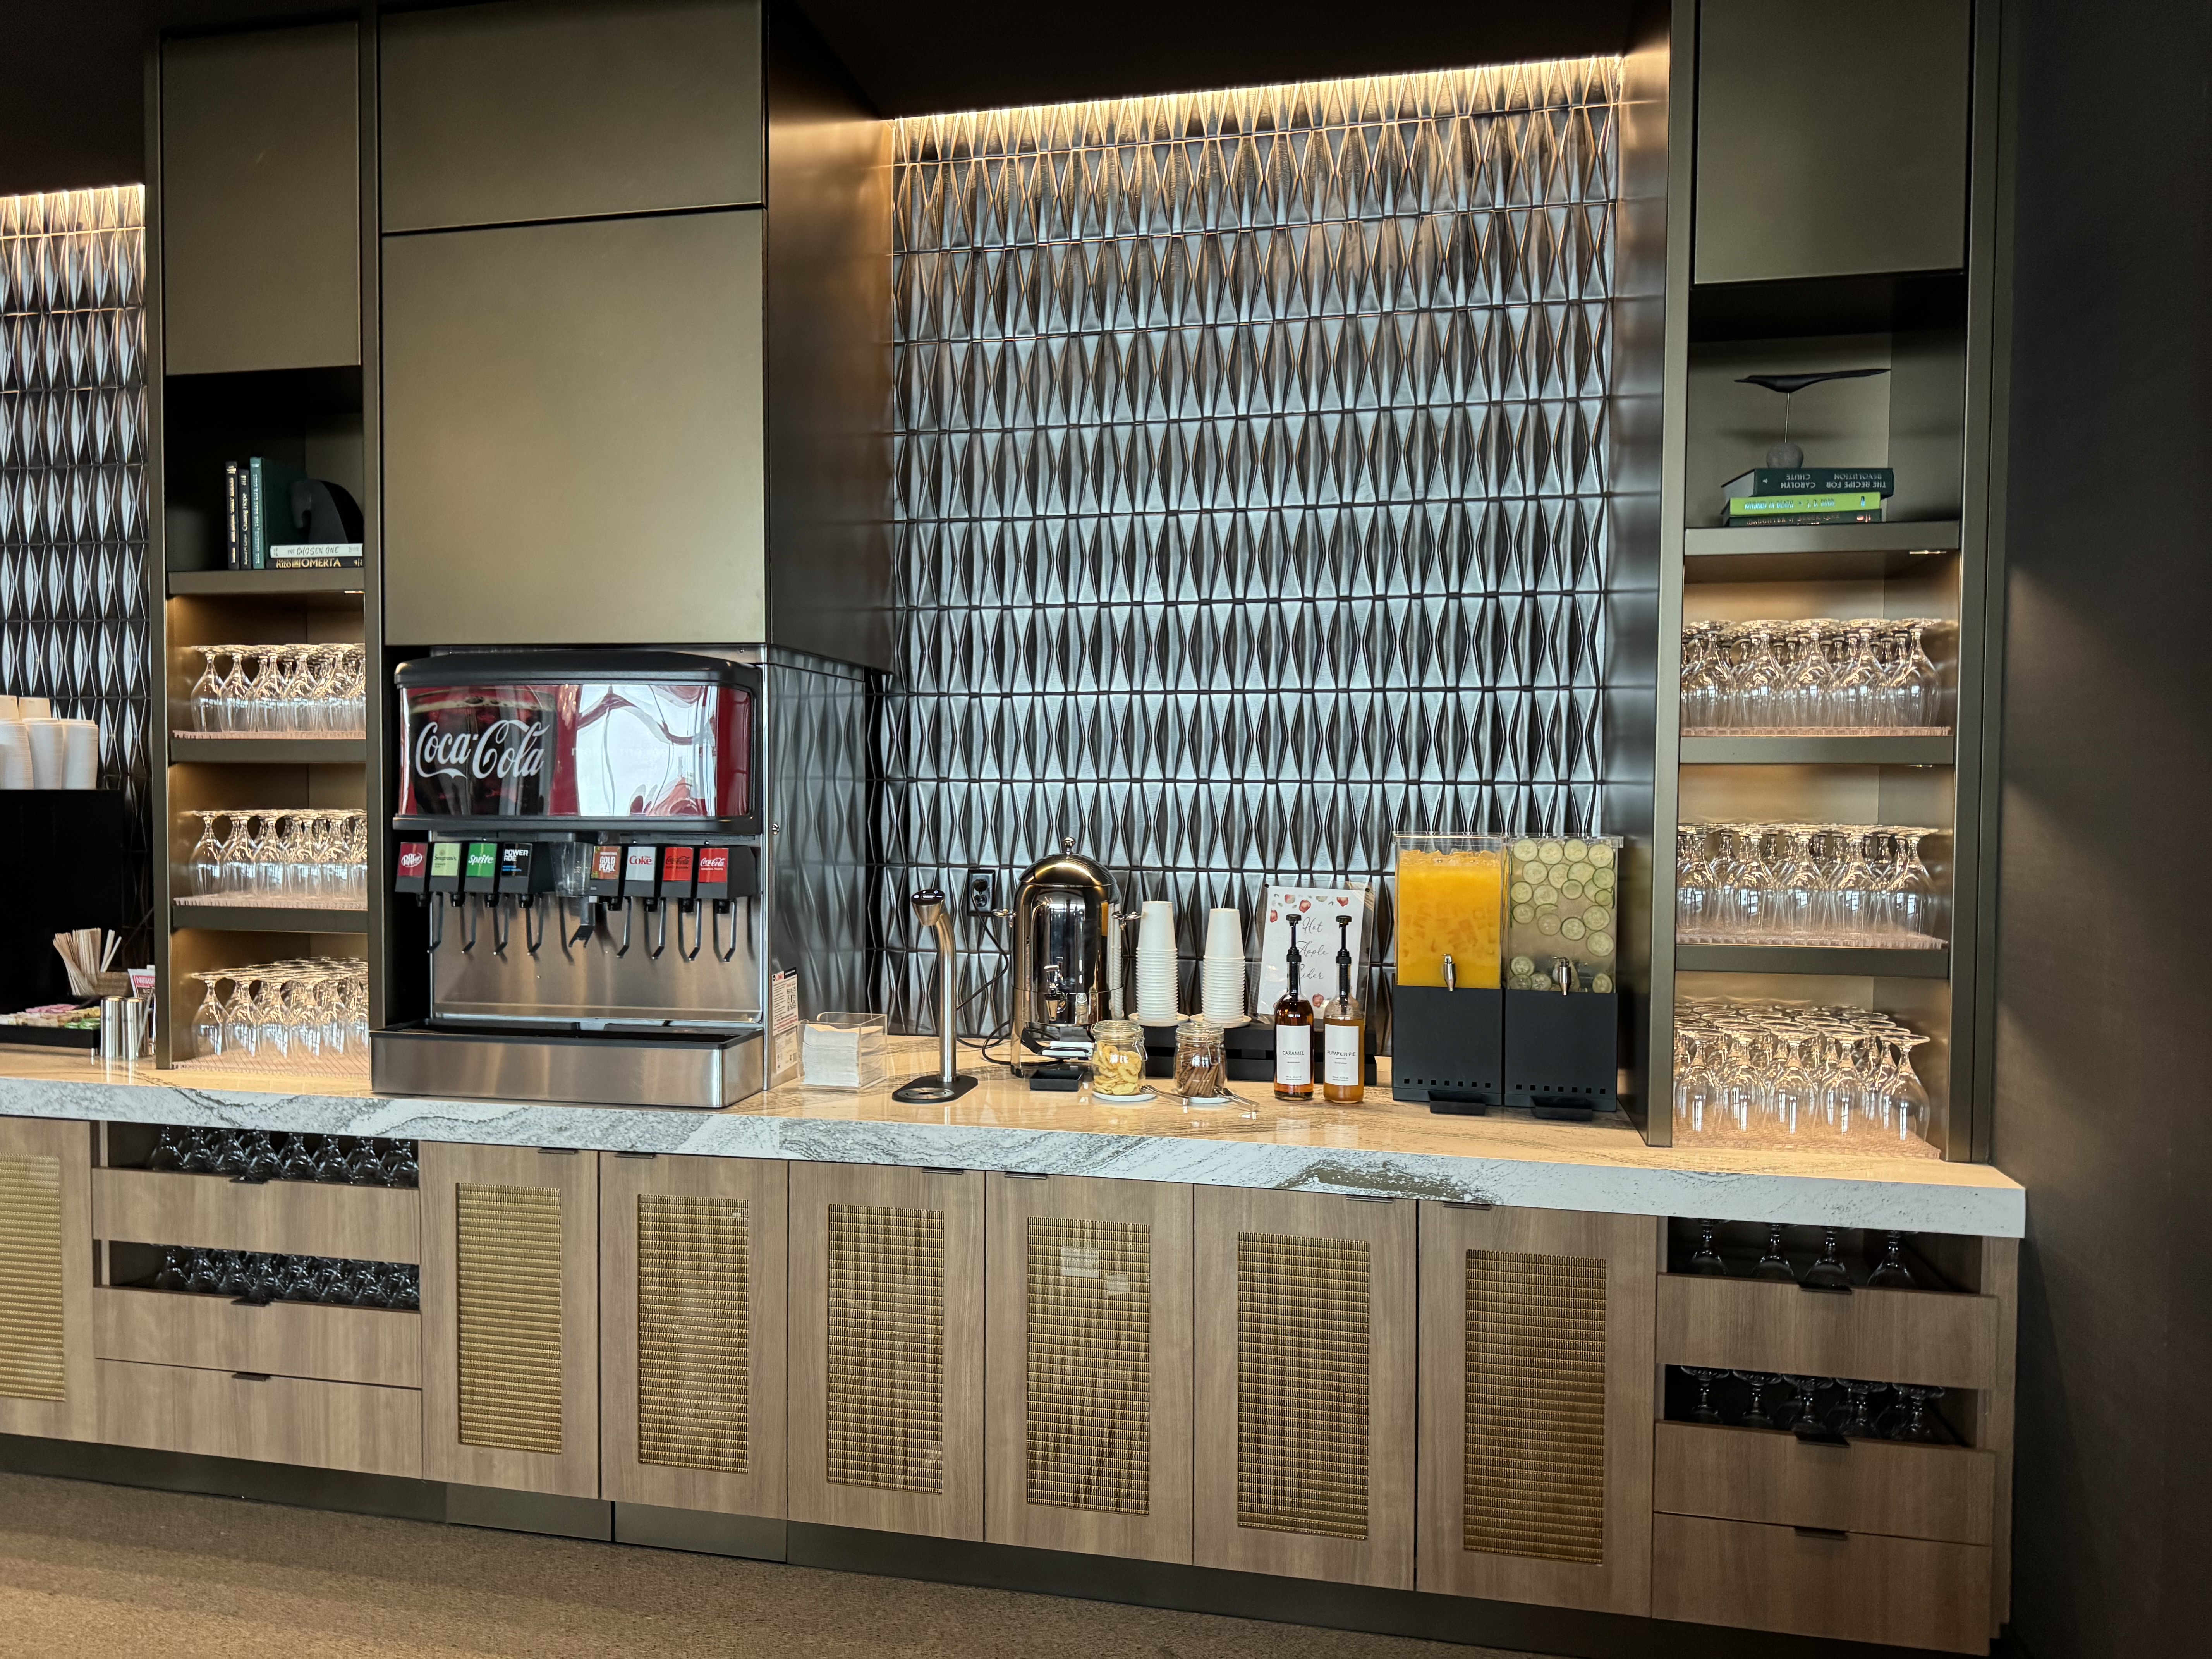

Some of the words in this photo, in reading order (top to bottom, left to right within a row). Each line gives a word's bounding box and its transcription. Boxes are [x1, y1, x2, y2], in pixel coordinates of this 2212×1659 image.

[1776, 500, 1794, 508] DEATH
[297, 546, 323, 556] CHOSEN
[325, 546, 339, 555] ONE
[301, 558, 341, 567] OMERTA
[416, 719, 550, 779] Coca-Cola
[468, 854, 494, 866] Sprite
[599, 856, 616, 864] GOLD
[629, 855, 653, 865] Coke
[700, 857, 726, 867] Coca-Cola
[1302, 917, 1323, 934] Hot
[1297, 940, 1329, 957] Apple
